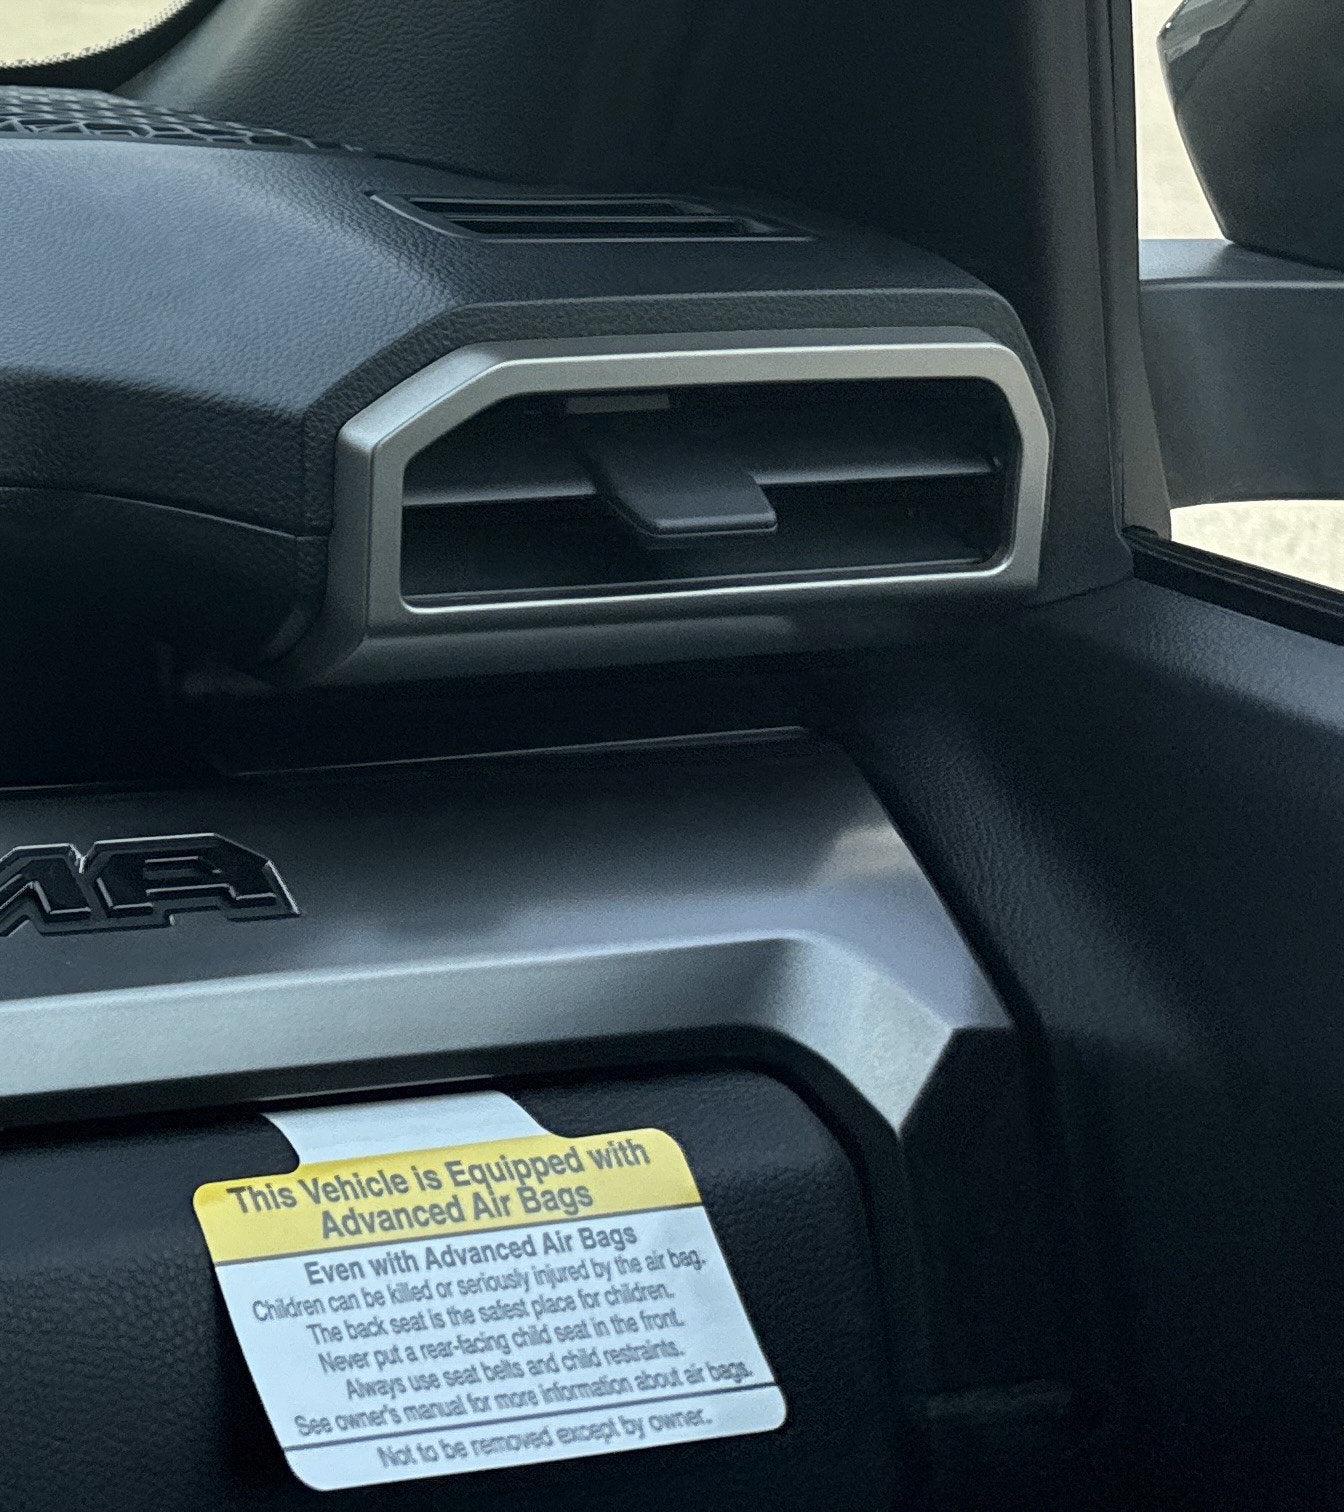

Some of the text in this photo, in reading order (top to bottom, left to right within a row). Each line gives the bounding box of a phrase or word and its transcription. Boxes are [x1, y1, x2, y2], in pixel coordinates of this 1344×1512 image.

[226, 1138, 651, 1213] This Vehicle is Equipped with
[320, 1185, 594, 1239] Advanced Air Bags
[252, 1248, 707, 1322] Children can be killed or seriously injured by the air bag.
[304, 1225, 638, 1286] Even with Advanced Air Bags
[306, 1282, 676, 1345] The back seat is the safest place for children.
[318, 1350, 369, 1374] Never
[374, 1343, 403, 1371] put
[404, 1345, 418, 1362] a
[512, 1324, 553, 1348] child
[554, 1319, 592, 1342] seat
[592, 1317, 610, 1338] in
[610, 1313, 639, 1335] the
[294, 1414, 333, 1437] See
[403, 1394, 468, 1422] manual
[467, 1392, 490, 1413] for
[494, 1388, 539, 1409] more
[539, 1376, 633, 1405] information
[634, 1367, 683, 1391] about
[684, 1363, 705, 1384] air
[345, 1374, 407, 1401] Always
[407, 1371, 441, 1392] use
[442, 1364, 481, 1387] seat
[481, 1358, 525, 1382] belts
[526, 1353, 559, 1376] and
[562, 1346, 602, 1370] child
[377, 1408, 713, 1468] Not to be removed except by owner.
